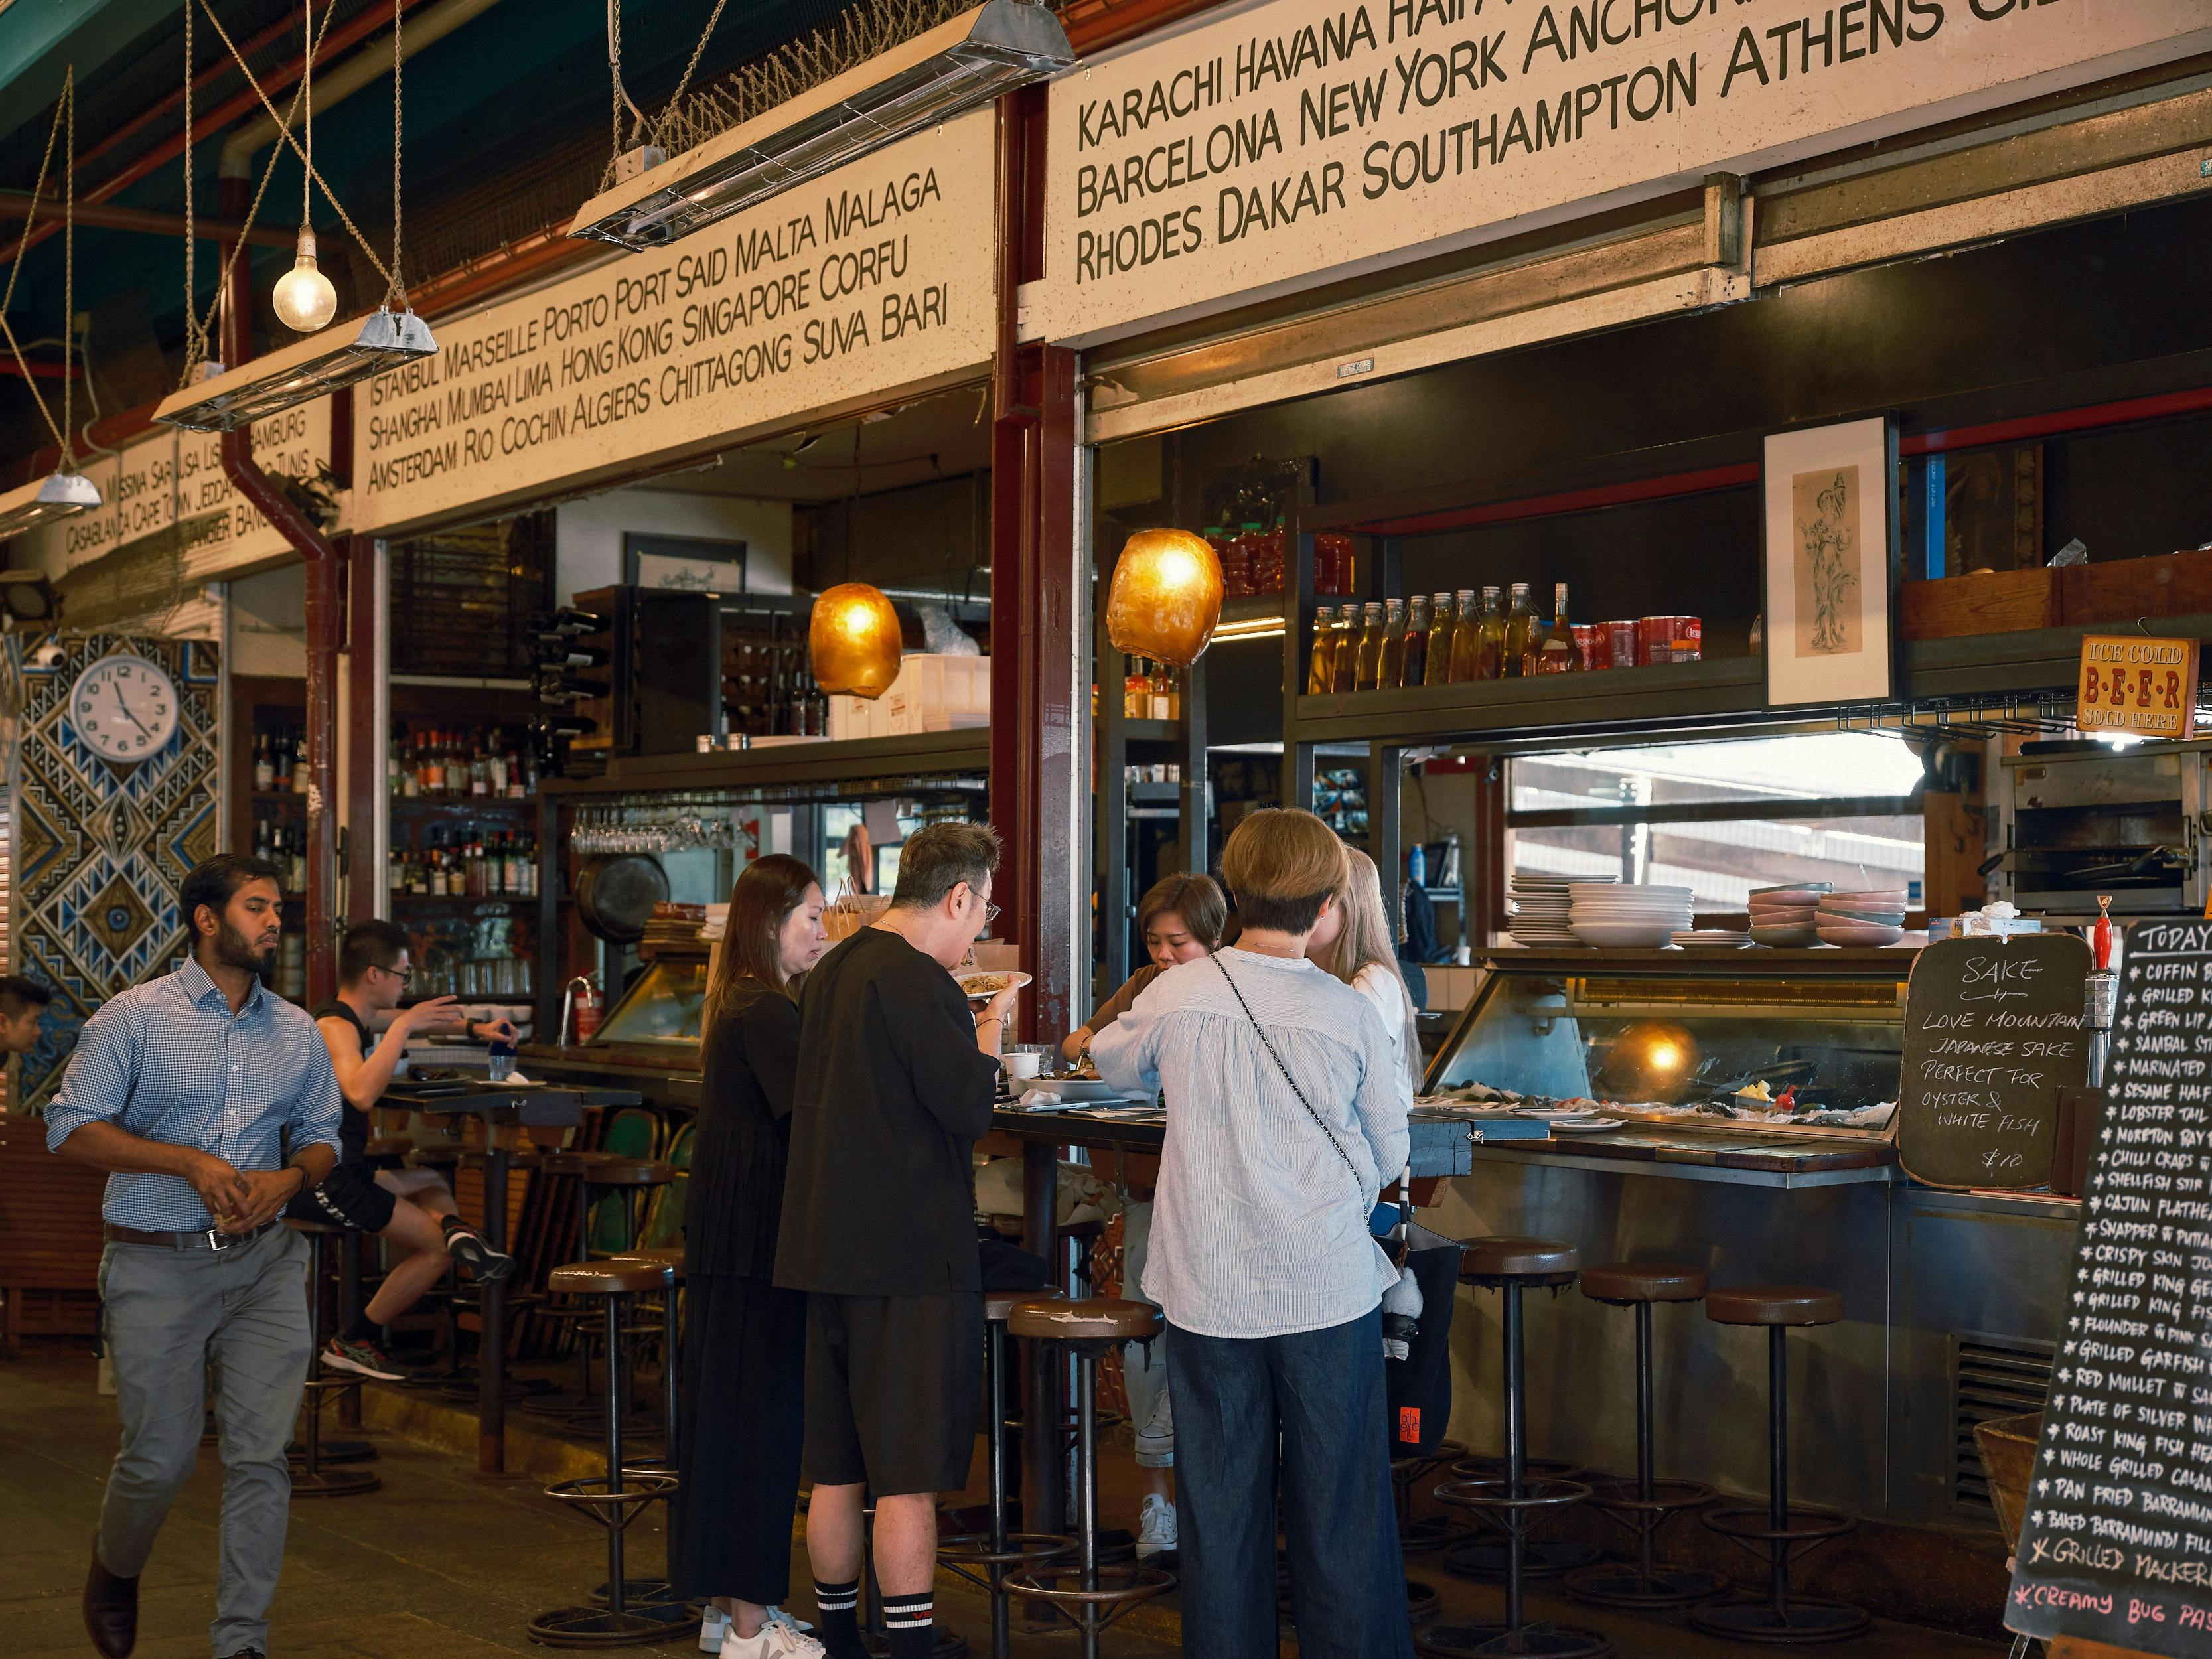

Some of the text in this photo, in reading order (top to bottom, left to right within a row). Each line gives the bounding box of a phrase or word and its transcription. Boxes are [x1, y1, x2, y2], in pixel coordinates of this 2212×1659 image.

[1078, 0, 1513, 152] KARACHI HAVANA HAI
[1078, 108, 1283, 218] BARCELONA
[1300, 68, 1388, 147] NEW
[1394, 30, 1507, 114] YORK
[1076, 0, 1945, 285] RHODES DAKAR SOUTHAMPTON ATHENS
[370, 167, 941, 407] ISTANBUL MARSEILLE PORTO PORT SAID MALTA MALAGA
[369, 234, 908, 451] SHANGHAI MUMBAI LIMA HONG KONG SINGAPORE CORFU
[367, 283, 948, 495] AMSTERDAM RIO COCHIN ALGIERS CHITTAGONG SUVA BARI
[106, 470, 148, 506] MSSINA
[196, 478, 236, 510] JEDDA
[2089, 644, 2183, 664] ICE COLD
[101, 670, 111, 681] 11
[117, 666, 130, 678] 12
[141, 672, 146, 683] 1
[86, 683, 99, 695] 10
[150, 685, 161, 697] 2
[80, 701, 92, 713] 9
[155, 703, 165, 715] 3
[85, 719, 98, 731] 8
[150, 722, 160, 732] 4
[2083, 709, 2179, 730] SOLD HERE
[100, 734, 110, 745] 7
[117, 739, 128, 751] 6
[136, 735, 147, 746] 5
[1962, 956, 2043, 983] SAKE
[2146, 960, 2198, 981] COFFIN
[2142, 987, 2194, 1008] GRILLED
[1922, 1011, 2085, 1031] LOVE MOUNTAIN
[2137, 1009, 2181, 1034] GREEN
[2185, 1012, 2206, 1029] LIP
[1930, 1037, 2075, 1058] JAPANESE SAKE
[2134, 1035, 2189, 1054] SAMBAL
[1921, 1060, 2043, 1088] PERFECT FOR
[2129, 1058, 2205, 1078] MARINATED
[1921, 1091, 2002, 1112] OYSTER &
[2124, 1082, 2212, 1102] SESAME HALF
[1938, 1112, 2041, 1137] WHITE FISH
[2121, 1104, 2209, 1123] LOBSTER TAIL
[2116, 1126, 2173, 1146] MORETON
[2179, 1128, 2206, 1148] BAY
[1982, 1148, 2024, 1167] $10
[2110, 1149, 2151, 1167] CHILLI
[2155, 1151, 2194, 1171] CRABS
[2108, 1171, 2171, 1192] SHELLFISH
[2176, 1177, 2203, 1192] STIR
[2104, 1193, 2150, 1213] CAJUN
[2099, 1218, 2158, 1241] SNAPPER
[2095, 1244, 2148, 1269] CRISPY
[2152, 1249, 2183, 1267] SKIN
[2092, 1267, 2146, 1288] GRILLED
[2152, 1273, 2186, 1299] KING
[2088, 1292, 2140, 1312] GRILLED
[2148, 1296, 2182, 1323] KING
[2083, 1315, 2149, 1337] FLOUNDER
[2167, 1327, 2195, 1344] PINK
[2079, 1338, 2134, 1363] GRILLED
[2140, 1348, 2205, 1374] GARFISH
[2075, 1367, 2103, 1388] RED
[2108, 1371, 2167, 1397] MULLET
[2070, 1394, 2108, 1417] PLATE
[2113, 1403, 2132, 1421] OF
[2137, 1406, 2187, 1432] SILVER
[2065, 1421, 2107, 1444] ROAST
[2113, 1429, 2148, 1459] KING
[2154, 1435, 2185, 1457] FISH
[2060, 1449, 2102, 1471] WHOLE
[2108, 1457, 2164, 1480] GRILLED
[2055, 1477, 2086, 1501] PAN
[2093, 1486, 2134, 1507] FRIED
[2047, 1510, 2087, 1532] BAKED
[2090, 1515, 2179, 1550] BARRAMUNDI
[2053, 1537, 2124, 1571] GRILLED
[2128, 1598, 2166, 1624] BUG
